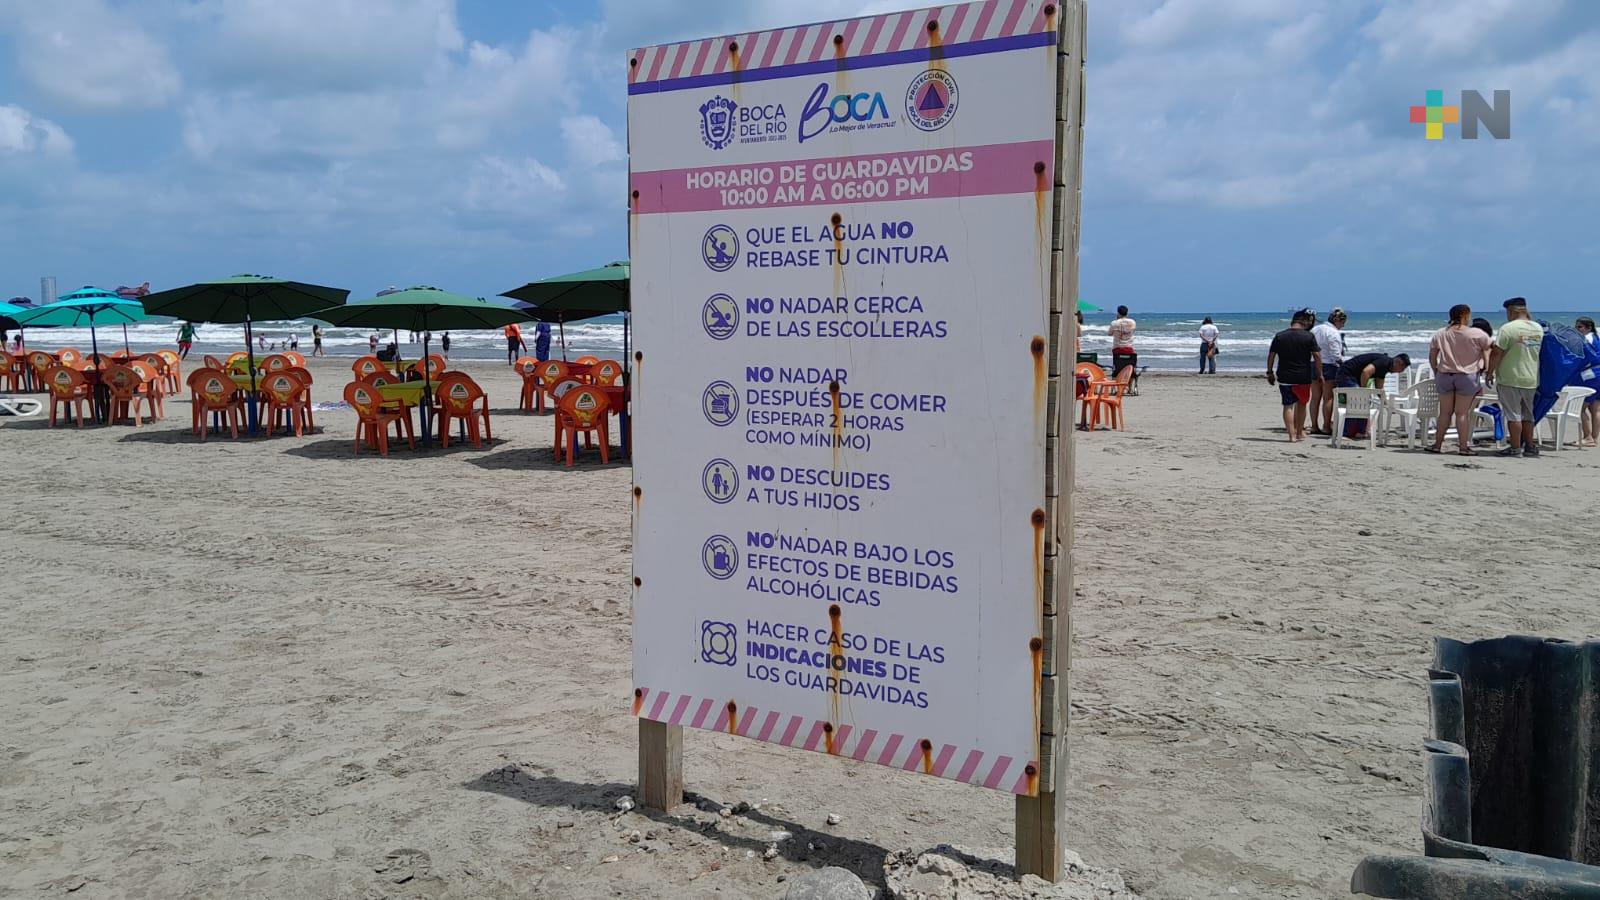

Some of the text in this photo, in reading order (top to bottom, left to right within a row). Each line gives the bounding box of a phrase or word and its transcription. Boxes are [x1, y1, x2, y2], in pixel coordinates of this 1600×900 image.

[909, 72, 955, 100] PROTECCIÓN CIVIL
[740, 104, 786, 122] BOCA
[909, 106, 921, 124] BOCA
[740, 119, 787, 136] DEL RÍO
[839, 124, 856, 132] Mejor
[686, 151, 973, 189] HORARIO DE GUARDAVIDAS
[720, 176, 929, 206] 10:00 AM A 06:00 PM
[746, 221, 914, 247] QUE EL AGUA NO
[746, 245, 949, 268] REBASE TU CINTURA
[746, 296, 923, 314] NO NADAR CERCA
[746, 320, 948, 338] DE LAS ESCOLLERAS
[746, 366, 848, 385] NO NADAR
[746, 388, 946, 412] DESPUÉS DE COMER
[746, 411, 904, 432] (ESPERAR 2 HORAS
[746, 429, 872, 452] COMO MÍNIMO)
[747, 464, 890, 491] NO DESCUIDES
[746, 487, 860, 511] A TUS HIJOS
[747, 531, 954, 569] NO NADAR BAJO LOS
[747, 553, 958, 593] EFECTOS DE BEBIDAS
[746, 575, 881, 607] ALCOHÓLICAS
[747, 619, 945, 664] HACER CASO DE LAS
[747, 641, 921, 684] INDICACIONES DE
[747, 663, 929, 709] LOS GUARDAVIDAS
